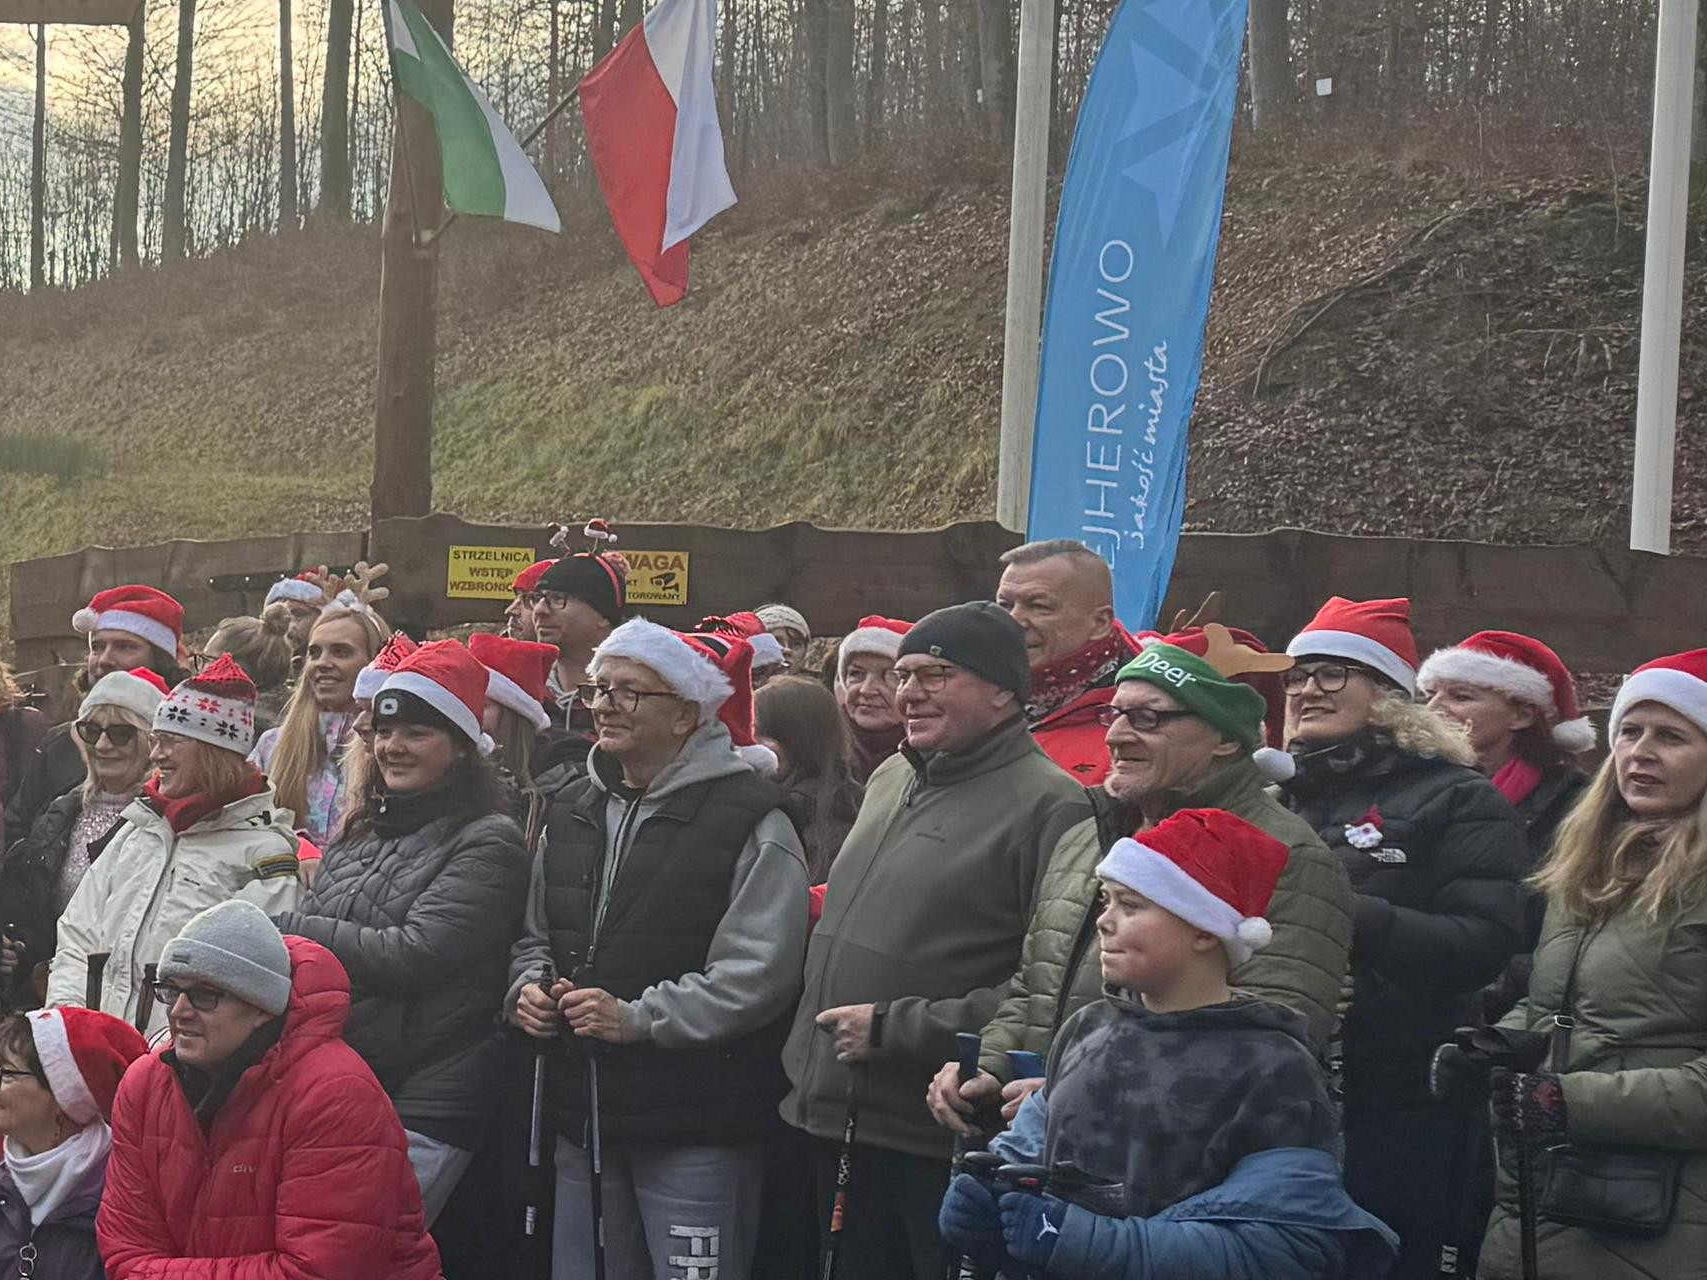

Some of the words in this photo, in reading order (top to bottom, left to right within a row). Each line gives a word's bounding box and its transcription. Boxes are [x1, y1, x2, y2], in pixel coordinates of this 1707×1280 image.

[1138, 340, 1169, 446] miasta
[1124, 448, 1154, 550] jakość
[453, 550, 530, 562] STRZELNICA
[469, 566, 513, 579] WSTĘP
[1134, 652, 1197, 687] Deer
